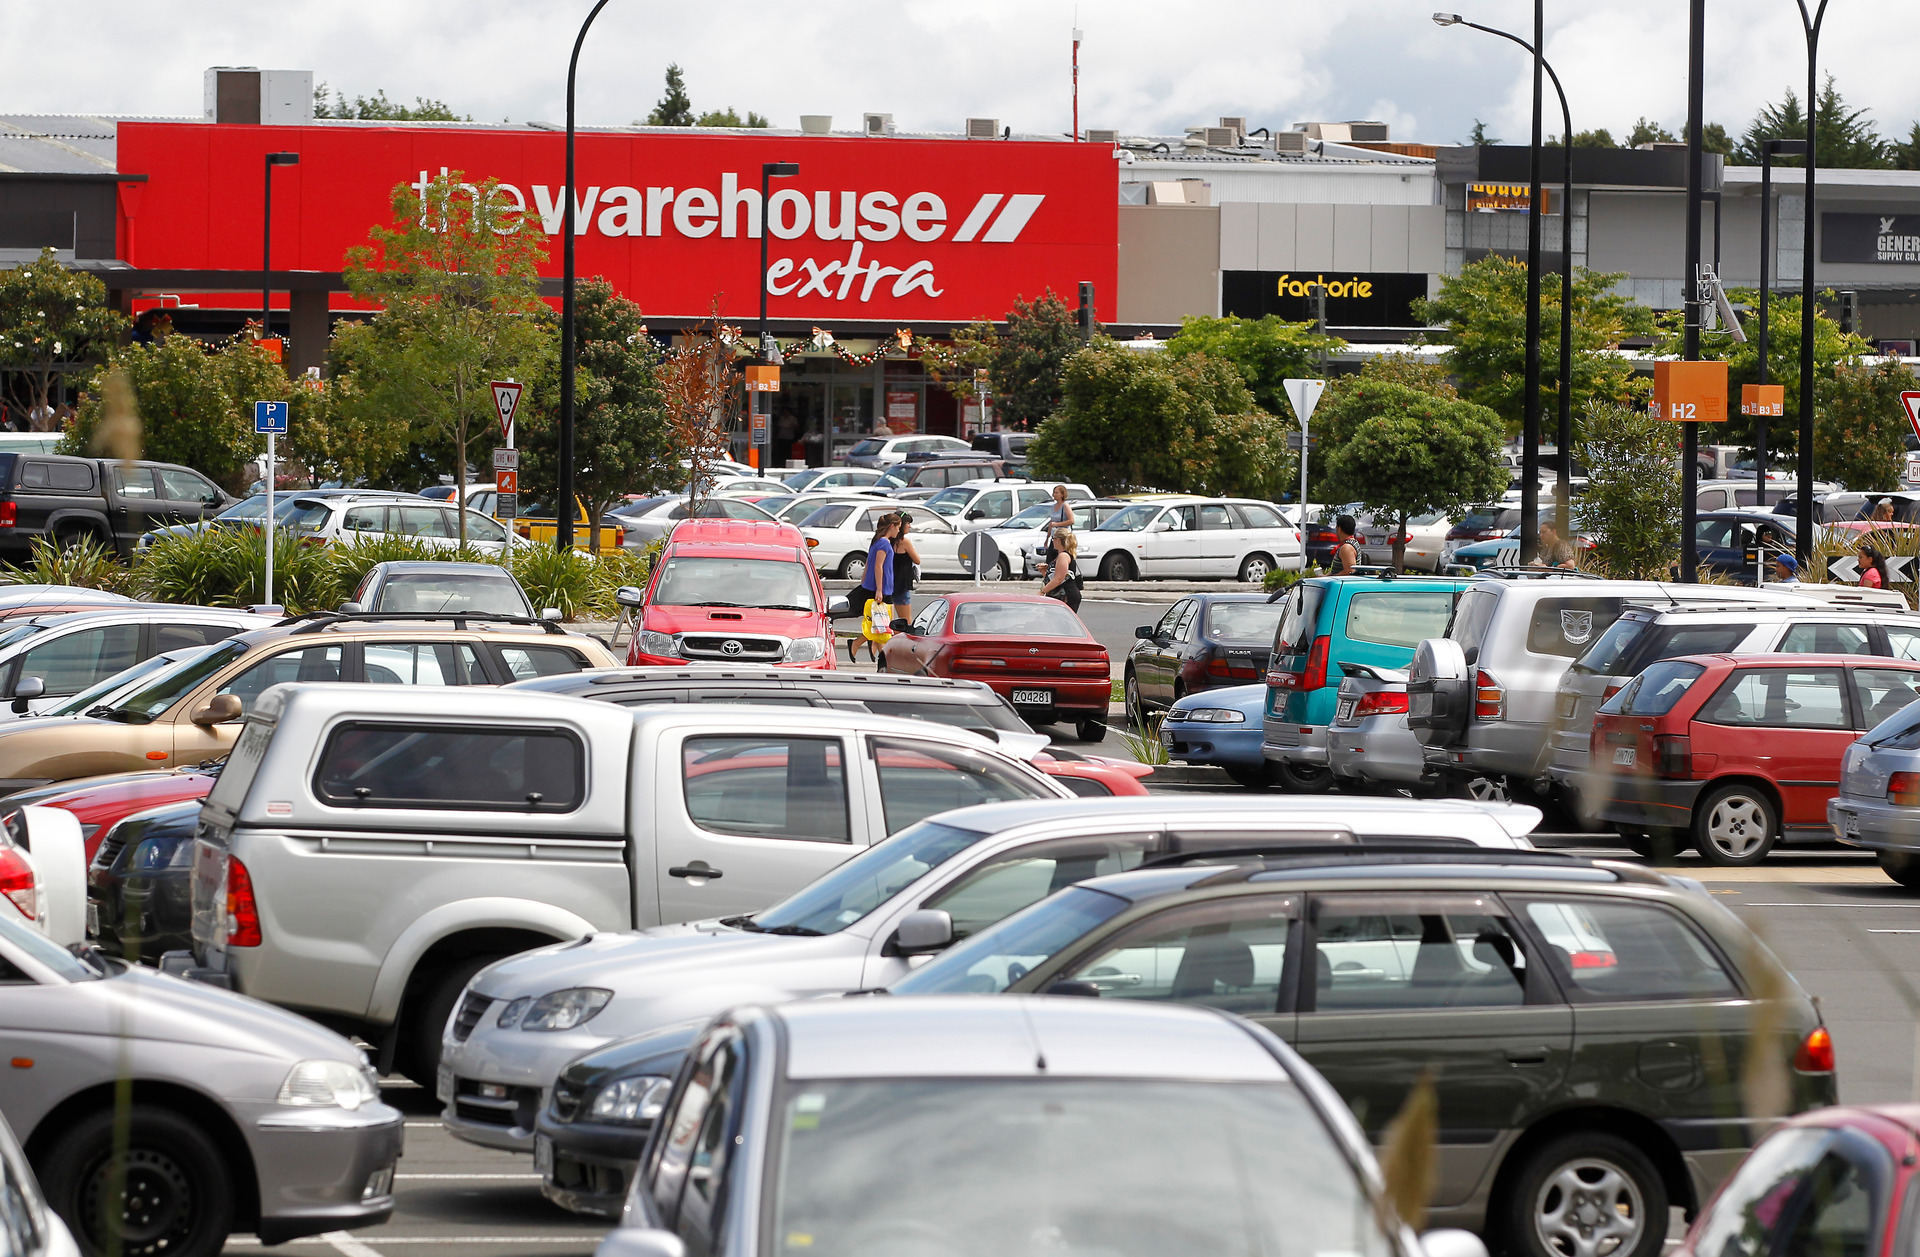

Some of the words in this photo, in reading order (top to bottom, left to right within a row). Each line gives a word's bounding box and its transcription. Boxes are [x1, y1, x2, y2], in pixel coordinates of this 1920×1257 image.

[1878, 252, 1903, 261] SUPPLY
[766, 240, 944, 302] extra
[1278, 274, 1372, 298] factorie
[266, 404, 276, 415] P
[1672, 403, 1696, 419] H2
[1742, 404, 1750, 413] B3
[1760, 406, 1770, 414] B3
[268, 418, 275, 426] 10
[496, 454, 505, 463] GIVE
[507, 454, 515, 463] WAY
[1014, 692, 1050, 703] ZQ4281
